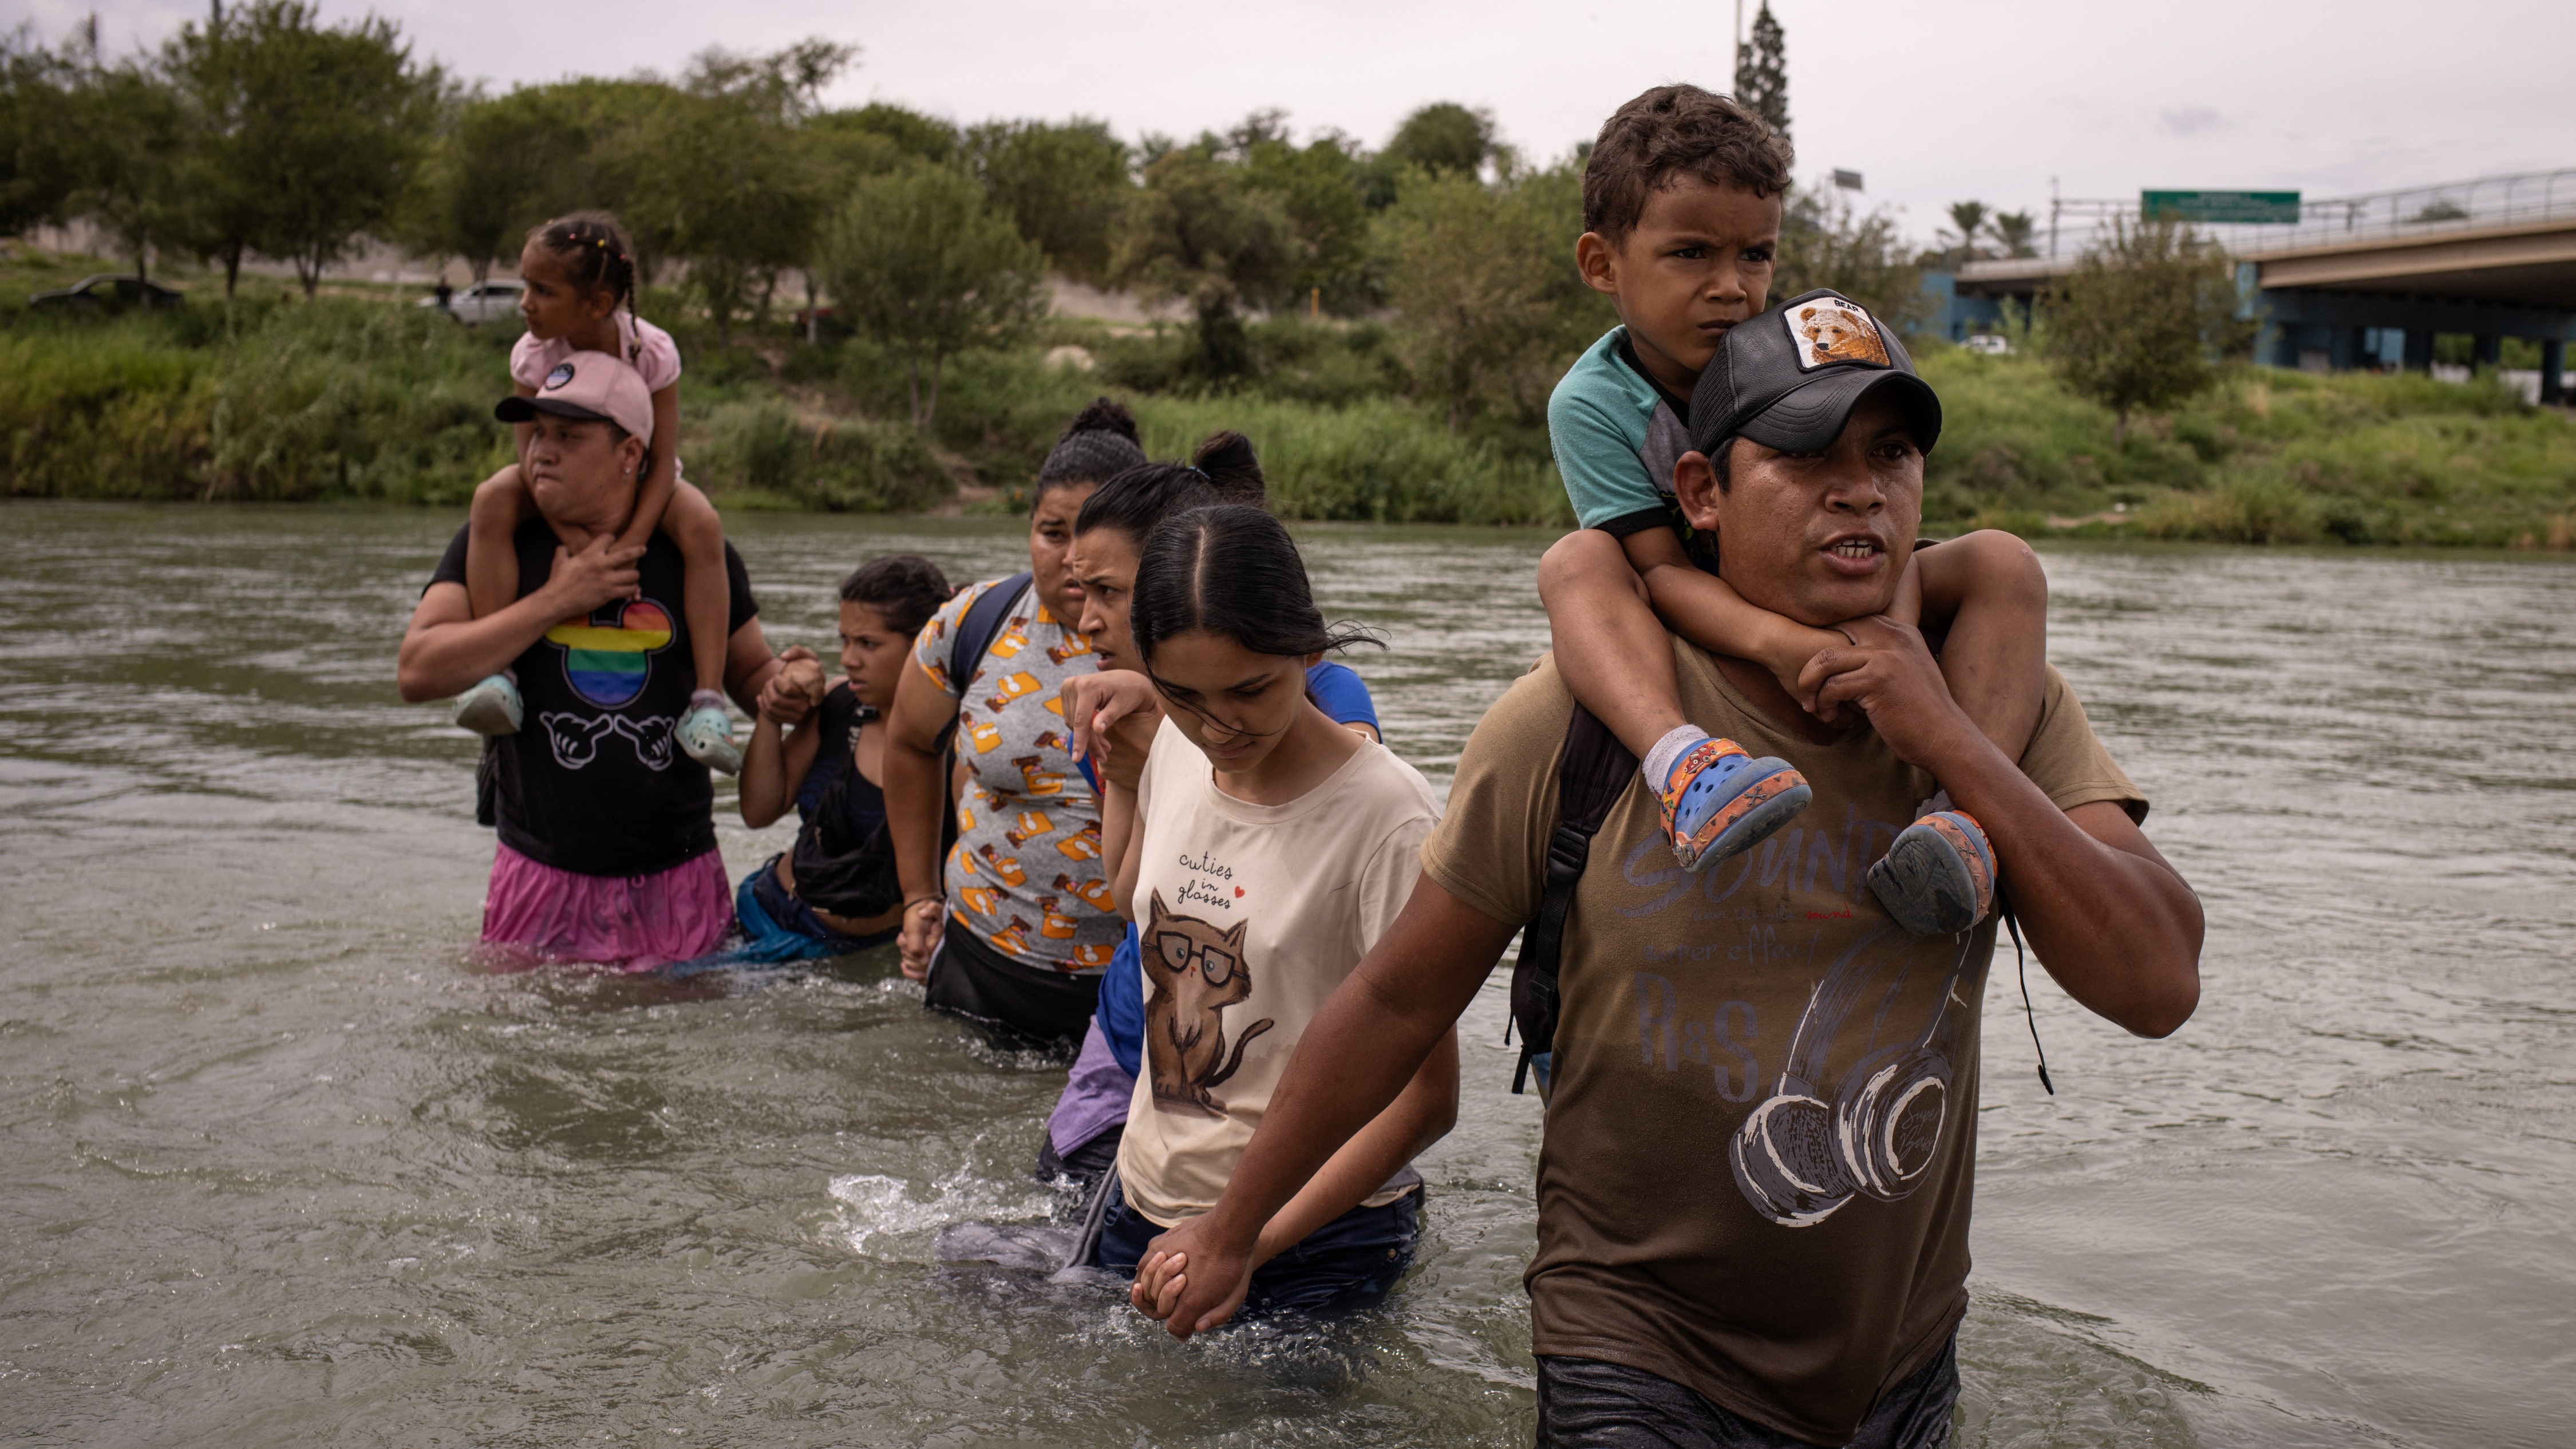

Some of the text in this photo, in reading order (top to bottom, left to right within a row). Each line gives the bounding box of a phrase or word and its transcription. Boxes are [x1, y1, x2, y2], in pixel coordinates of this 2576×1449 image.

[1834, 299, 1860, 312] BEAR
[1179, 851, 1233, 880] cuties
[1178, 879, 1231, 909] glasses
[1202, 878, 1219, 891] in
[1734, 906, 1759, 922] the
[1805, 901, 1854, 920] sound
[1642, 923, 1823, 969] super effect
[1901, 1095, 1942, 1135] Super
[1898, 1124, 1934, 1162] Bass
